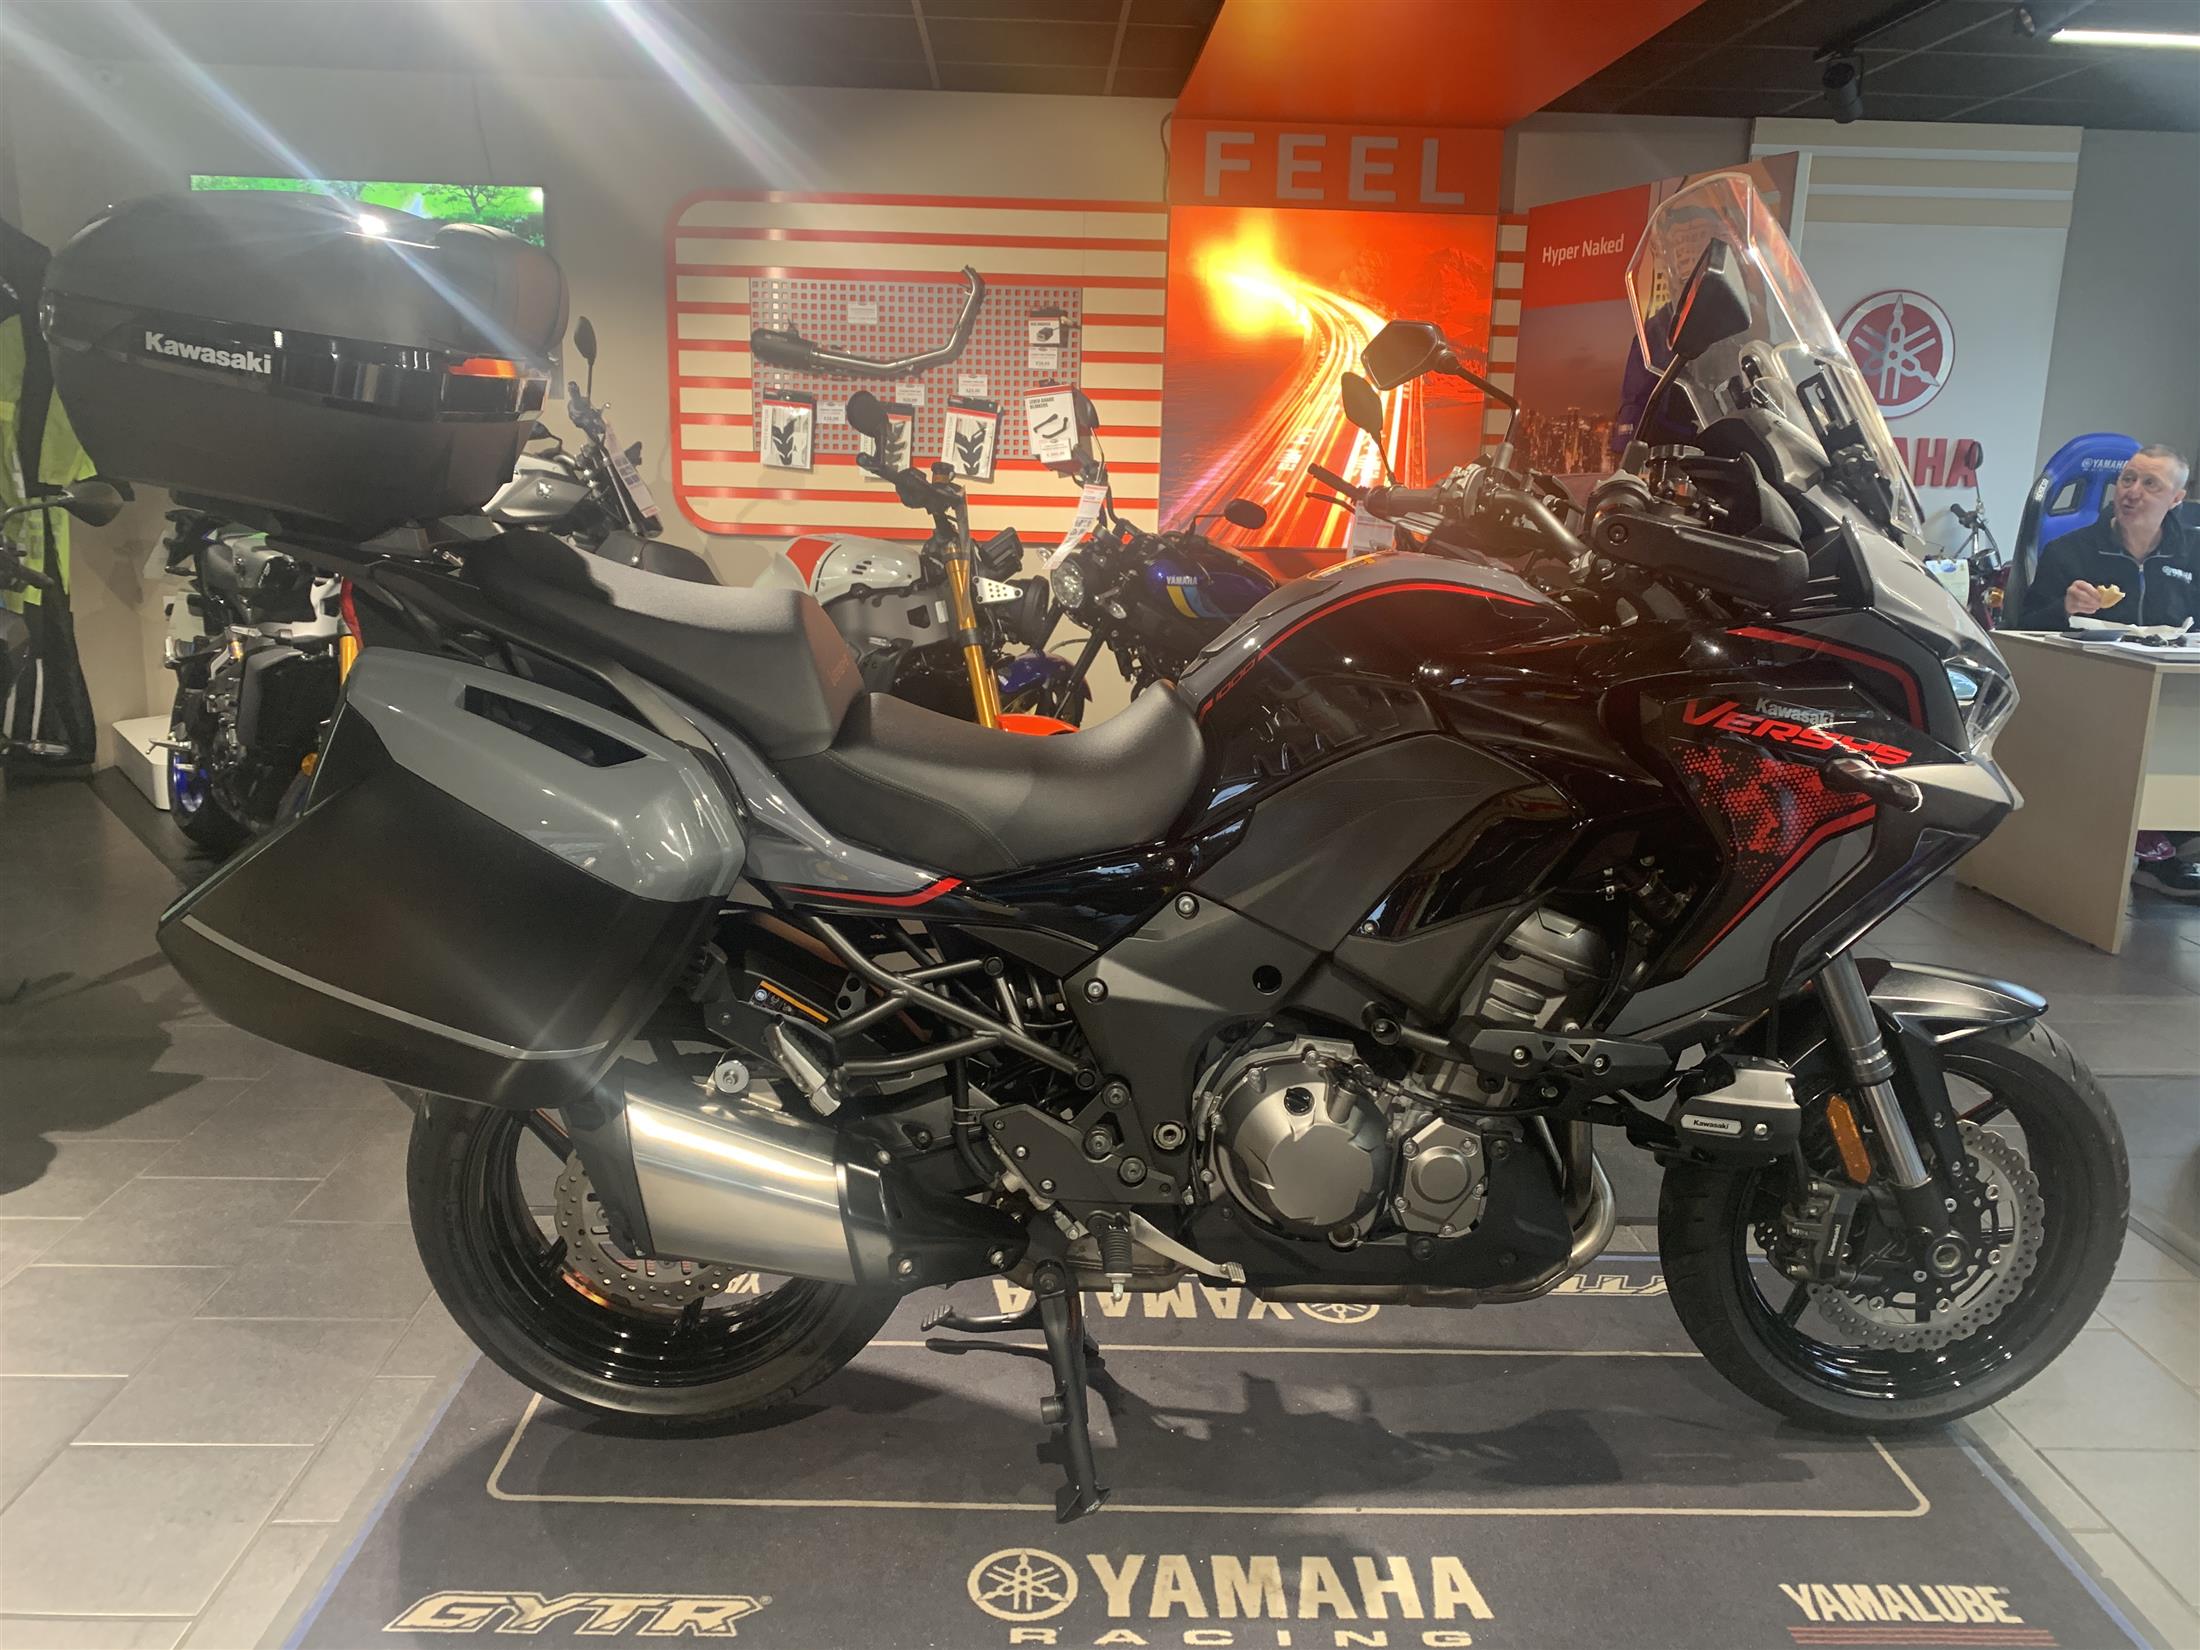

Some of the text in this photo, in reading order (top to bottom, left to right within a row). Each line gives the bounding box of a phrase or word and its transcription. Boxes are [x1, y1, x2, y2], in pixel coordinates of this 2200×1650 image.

[1204, 131, 1465, 205] FEEL
[1541, 233, 1625, 265] Hyper Naked
[144, 331, 272, 374] Kawasaki
[1682, 699, 1912, 765] VERSYS
[1756, 698, 1835, 728] Kawasaki
[1693, 1119, 1730, 1130] Kawasaki
[1086, 1553, 1495, 1619] YAMAHA
[1779, 1583, 2025, 1625] YAMALUBE
[1009, 1627, 1473, 1649] RACING
